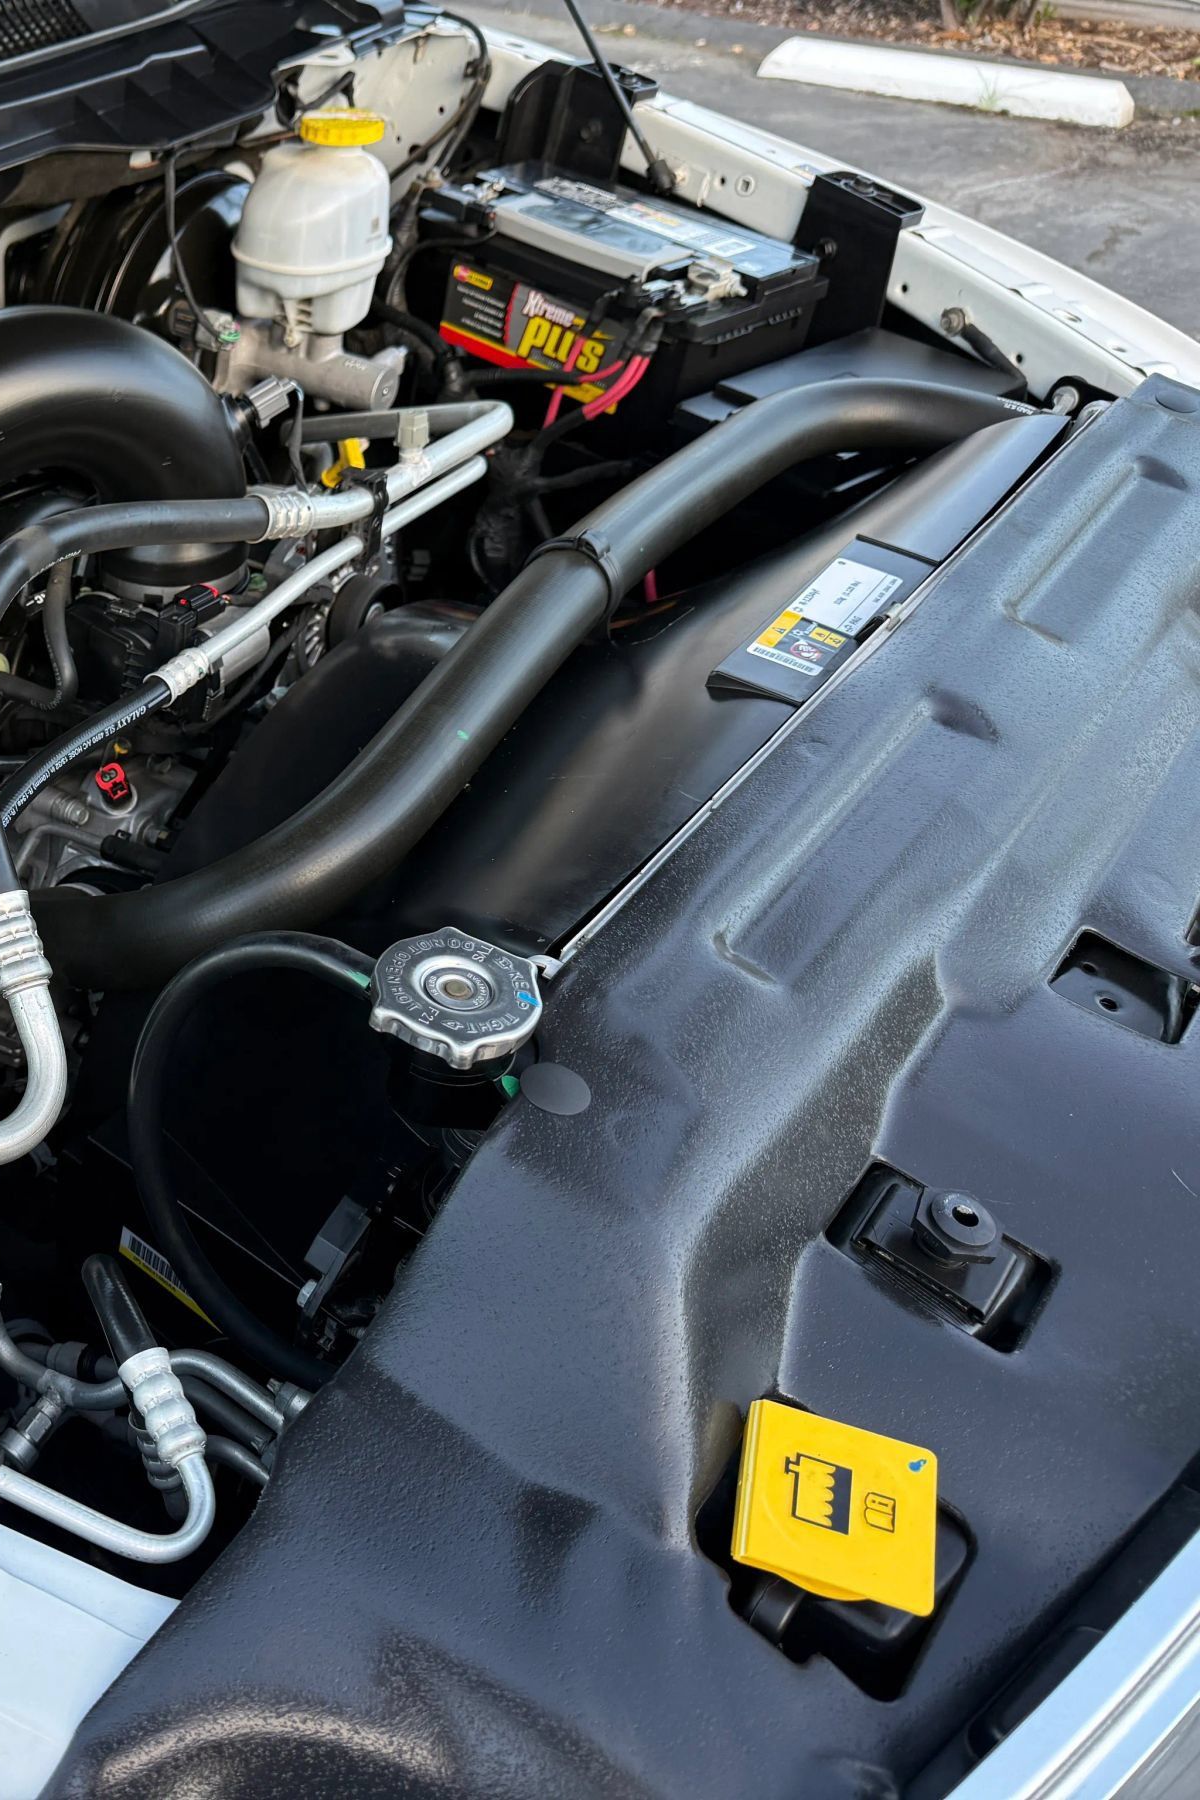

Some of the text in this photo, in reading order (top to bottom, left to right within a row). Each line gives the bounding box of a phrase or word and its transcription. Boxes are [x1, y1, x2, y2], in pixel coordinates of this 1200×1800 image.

[522, 290, 576, 328] Xtreme
[116, 705, 146, 731] GALAXY
[104, 724, 116, 737] SLE
[67, 745, 83, 760] HOSE
[2, 808, 17, 828] R-123
[471, 944, 493, 963] TVS
[385, 938, 476, 1013] DO NOT OPEN HOT
[418, 1006, 440, 1025] F21
[466, 1011, 520, 1034] TIGHT
